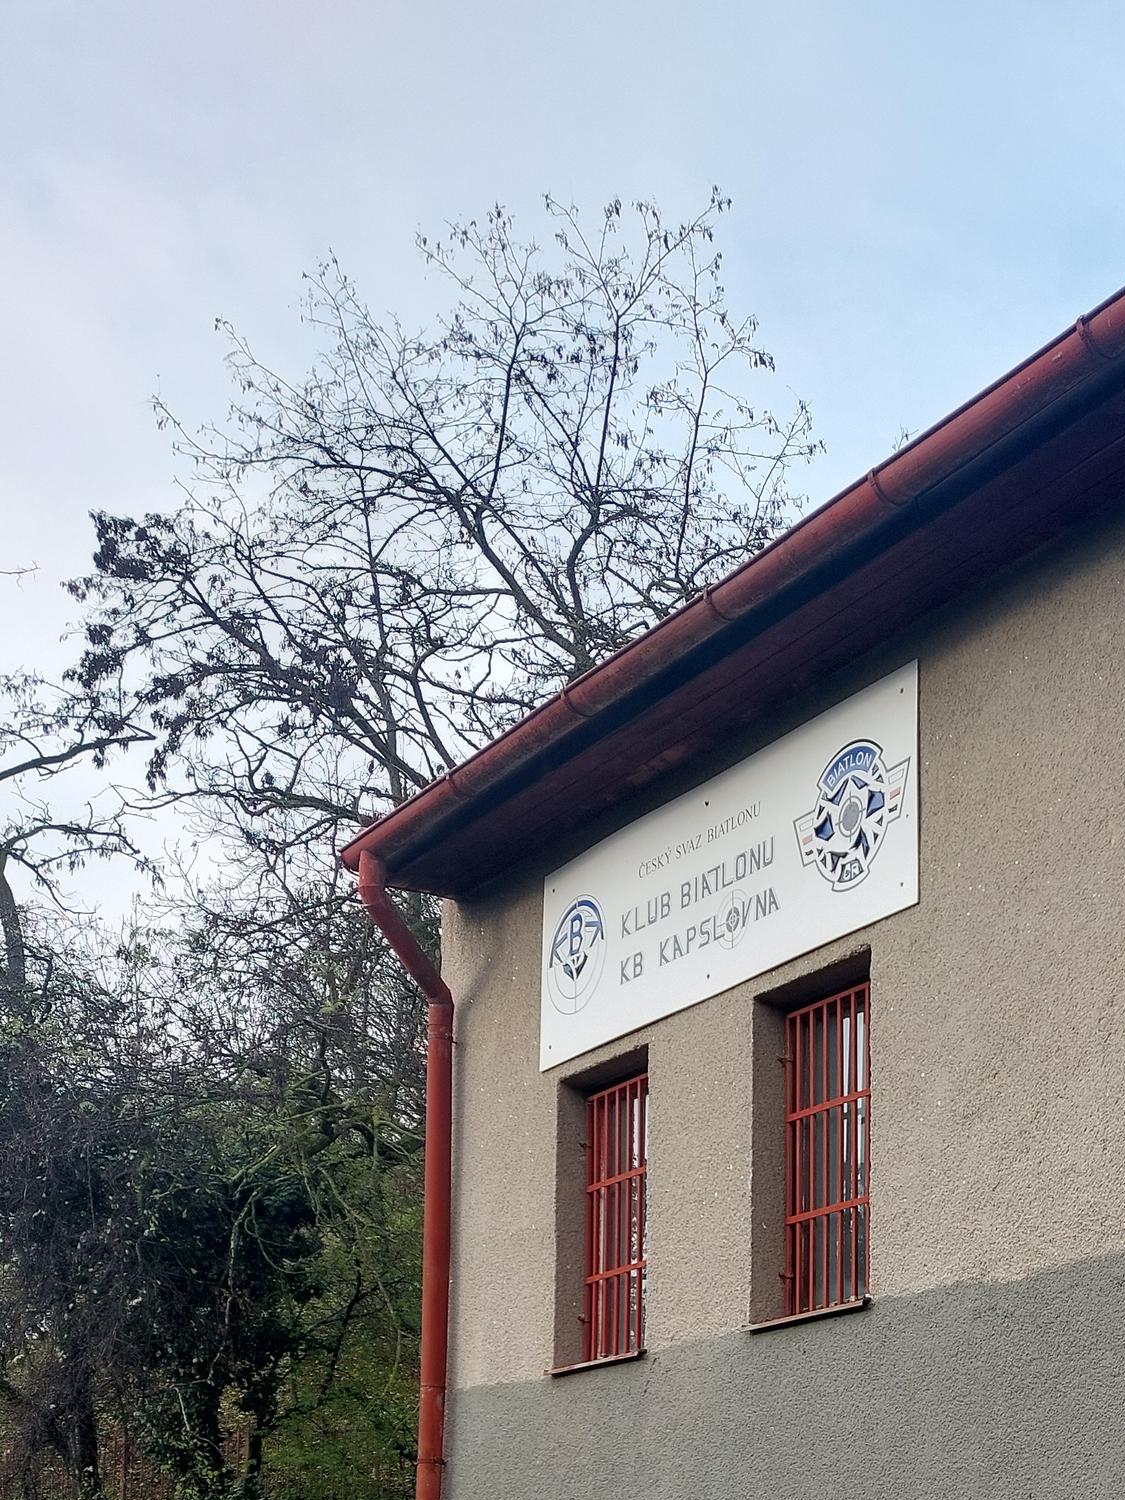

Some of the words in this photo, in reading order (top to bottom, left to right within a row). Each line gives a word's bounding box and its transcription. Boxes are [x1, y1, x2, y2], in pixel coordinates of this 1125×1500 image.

[826, 750, 873, 788] BIATLON
[638, 847, 672, 879] ČESKÝ
[675, 834, 702, 860] SVAZ
[707, 801, 761, 844] BIATLONU
[621, 891, 671, 939] KLUB
[680, 837, 775, 909] BIATLONU
[620, 951, 643, 985] KB
